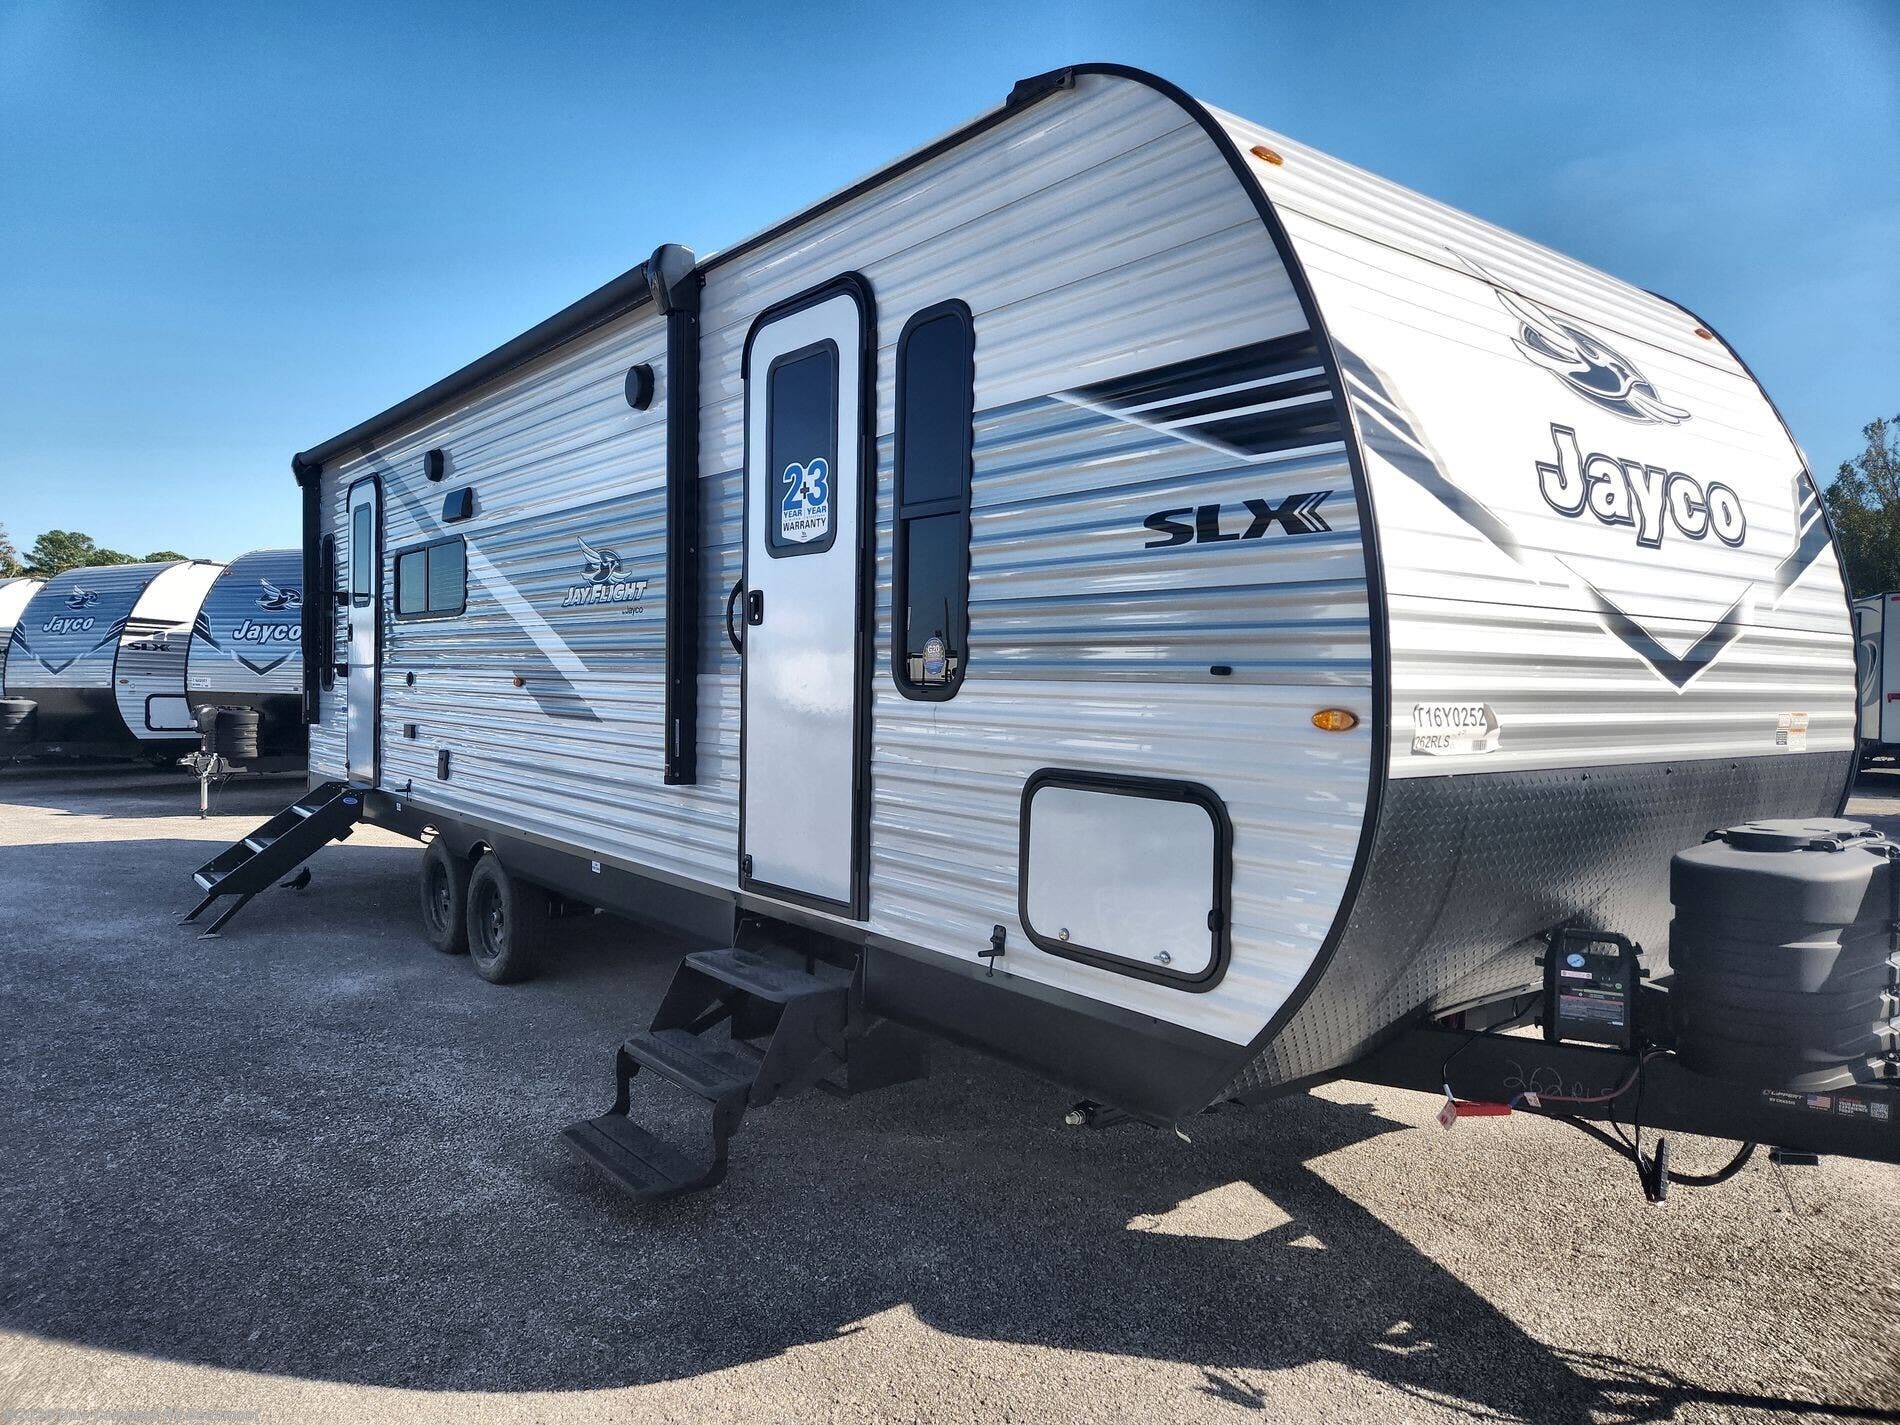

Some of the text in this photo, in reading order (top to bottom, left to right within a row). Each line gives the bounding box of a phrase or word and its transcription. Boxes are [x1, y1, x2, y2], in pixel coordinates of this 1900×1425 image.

[1535, 422, 1747, 550] Jayco
[783, 509, 803, 519] YEAR
[806, 505, 828, 516] YEAR
[1143, 489, 1334, 549] SLX
[782, 517, 827, 532] WARRANTY
[625, 605, 644, 616] Jayco
[42, 615, 96, 636] Jayco
[232, 618, 302, 646] Jayco
[128, 642, 172, 652] SLX
